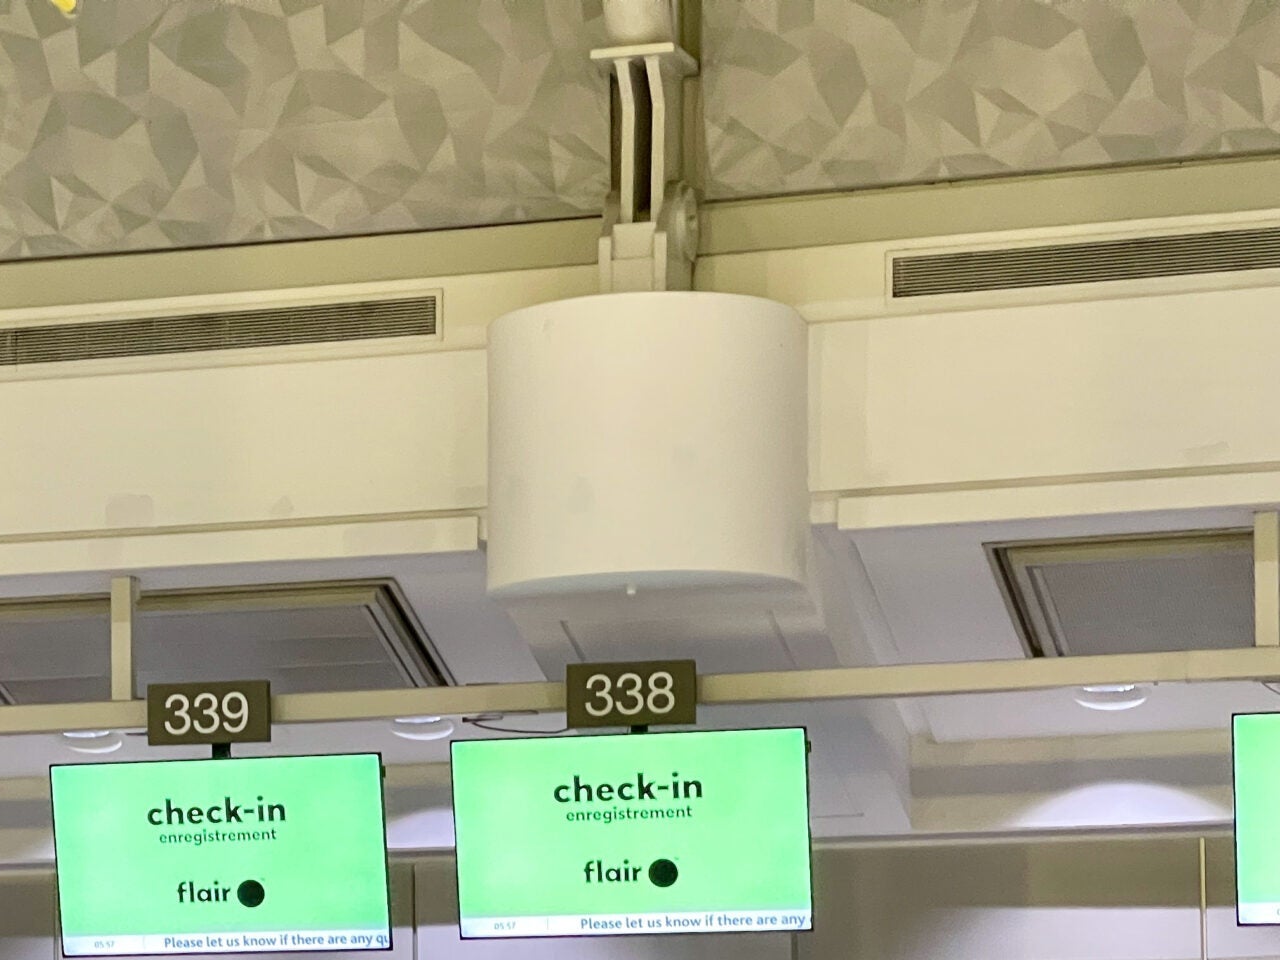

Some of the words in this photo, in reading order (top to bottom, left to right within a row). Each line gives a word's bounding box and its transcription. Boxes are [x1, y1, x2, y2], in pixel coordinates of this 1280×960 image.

[585, 672, 675, 716] 338
[164, 692, 249, 735] 339
[553, 772, 703, 803] check-in
[147, 796, 286, 826] check-in
[566, 805, 692, 823] enregistrement
[159, 827, 277, 845] enregistrement
[584, 860, 642, 884] flair
[178, 881, 231, 903] flair
[580, 918, 622, 930] Please
[626, 917, 644, 929] let
[647, 919, 662, 928] us
[665, 916, 701, 928] know
[705, 915, 714, 926] if
[717, 914, 753, 926] there
[757, 917, 777, 926] are
[781, 915, 806, 928] any
[164, 937, 203, 949] Please
[206, 936, 223, 947] let
[226, 938, 240, 947] us
[243, 935, 276, 946] know
[280, 934, 288, 945] if
[291, 934, 324, 945] there
[327, 936, 347, 945] are
[351, 935, 372, 947] any
